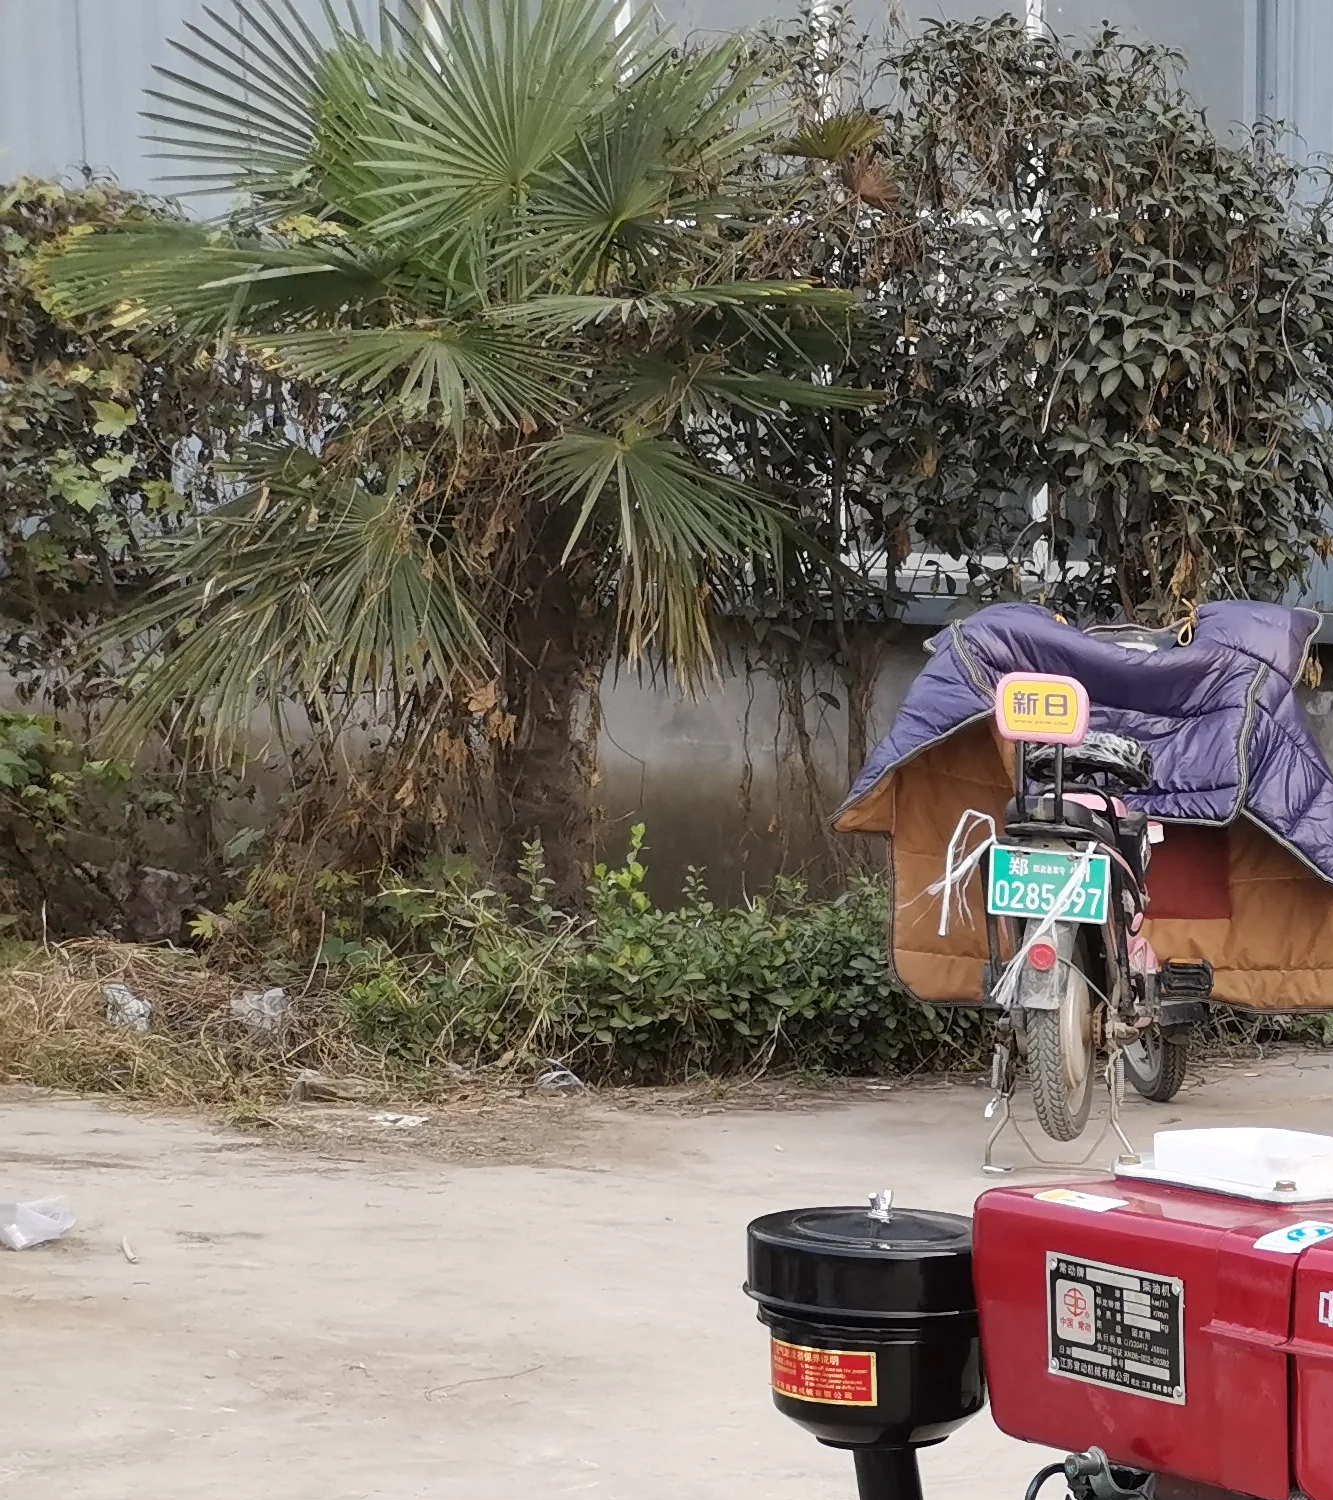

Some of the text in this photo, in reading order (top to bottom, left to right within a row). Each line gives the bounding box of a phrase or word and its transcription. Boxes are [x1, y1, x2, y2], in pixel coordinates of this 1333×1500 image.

[1013, 691, 1068, 717] 新日
[1009, 857, 1029, 876] 郑
[1059, 1262, 1171, 1298] 常动牌 柴油机
[1060, 1316, 1074, 1330] 中国
[1160, 1321, 1169, 1334] kg
